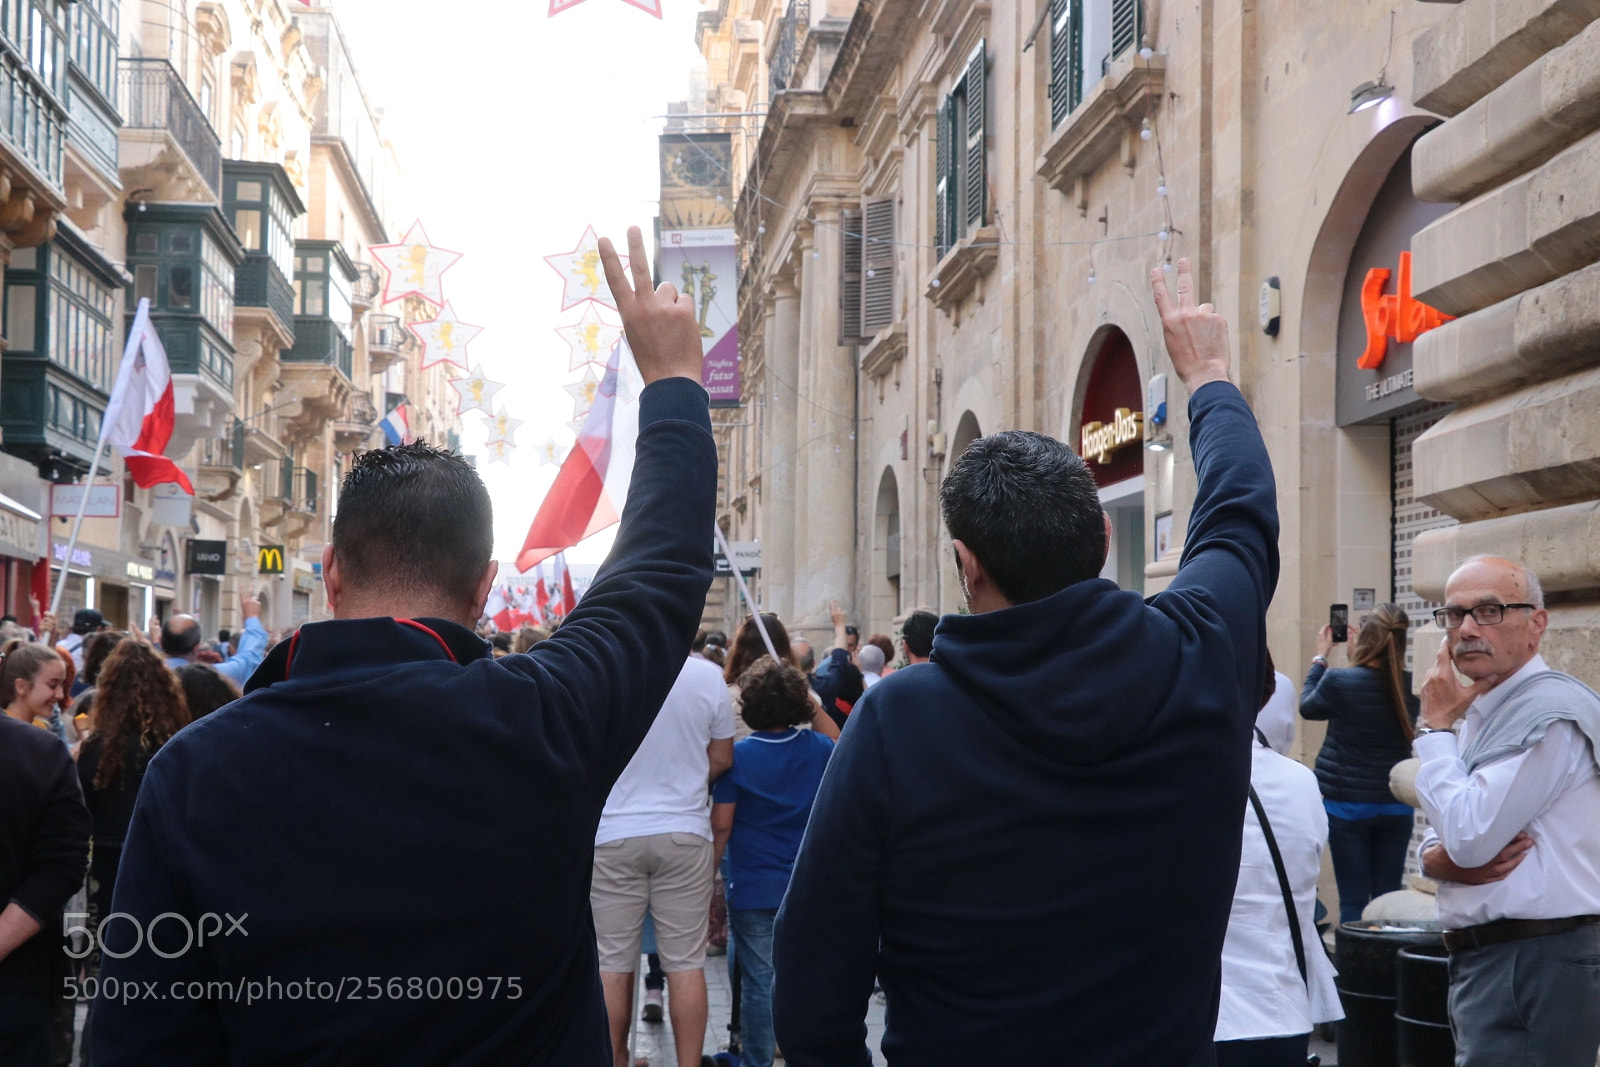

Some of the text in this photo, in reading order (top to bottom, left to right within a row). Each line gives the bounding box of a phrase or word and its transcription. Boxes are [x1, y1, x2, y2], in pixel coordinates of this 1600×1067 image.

[706, 369, 735, 383] futur
[1365, 382, 1380, 401] THE
[54, 495, 115, 506] MATLAN
